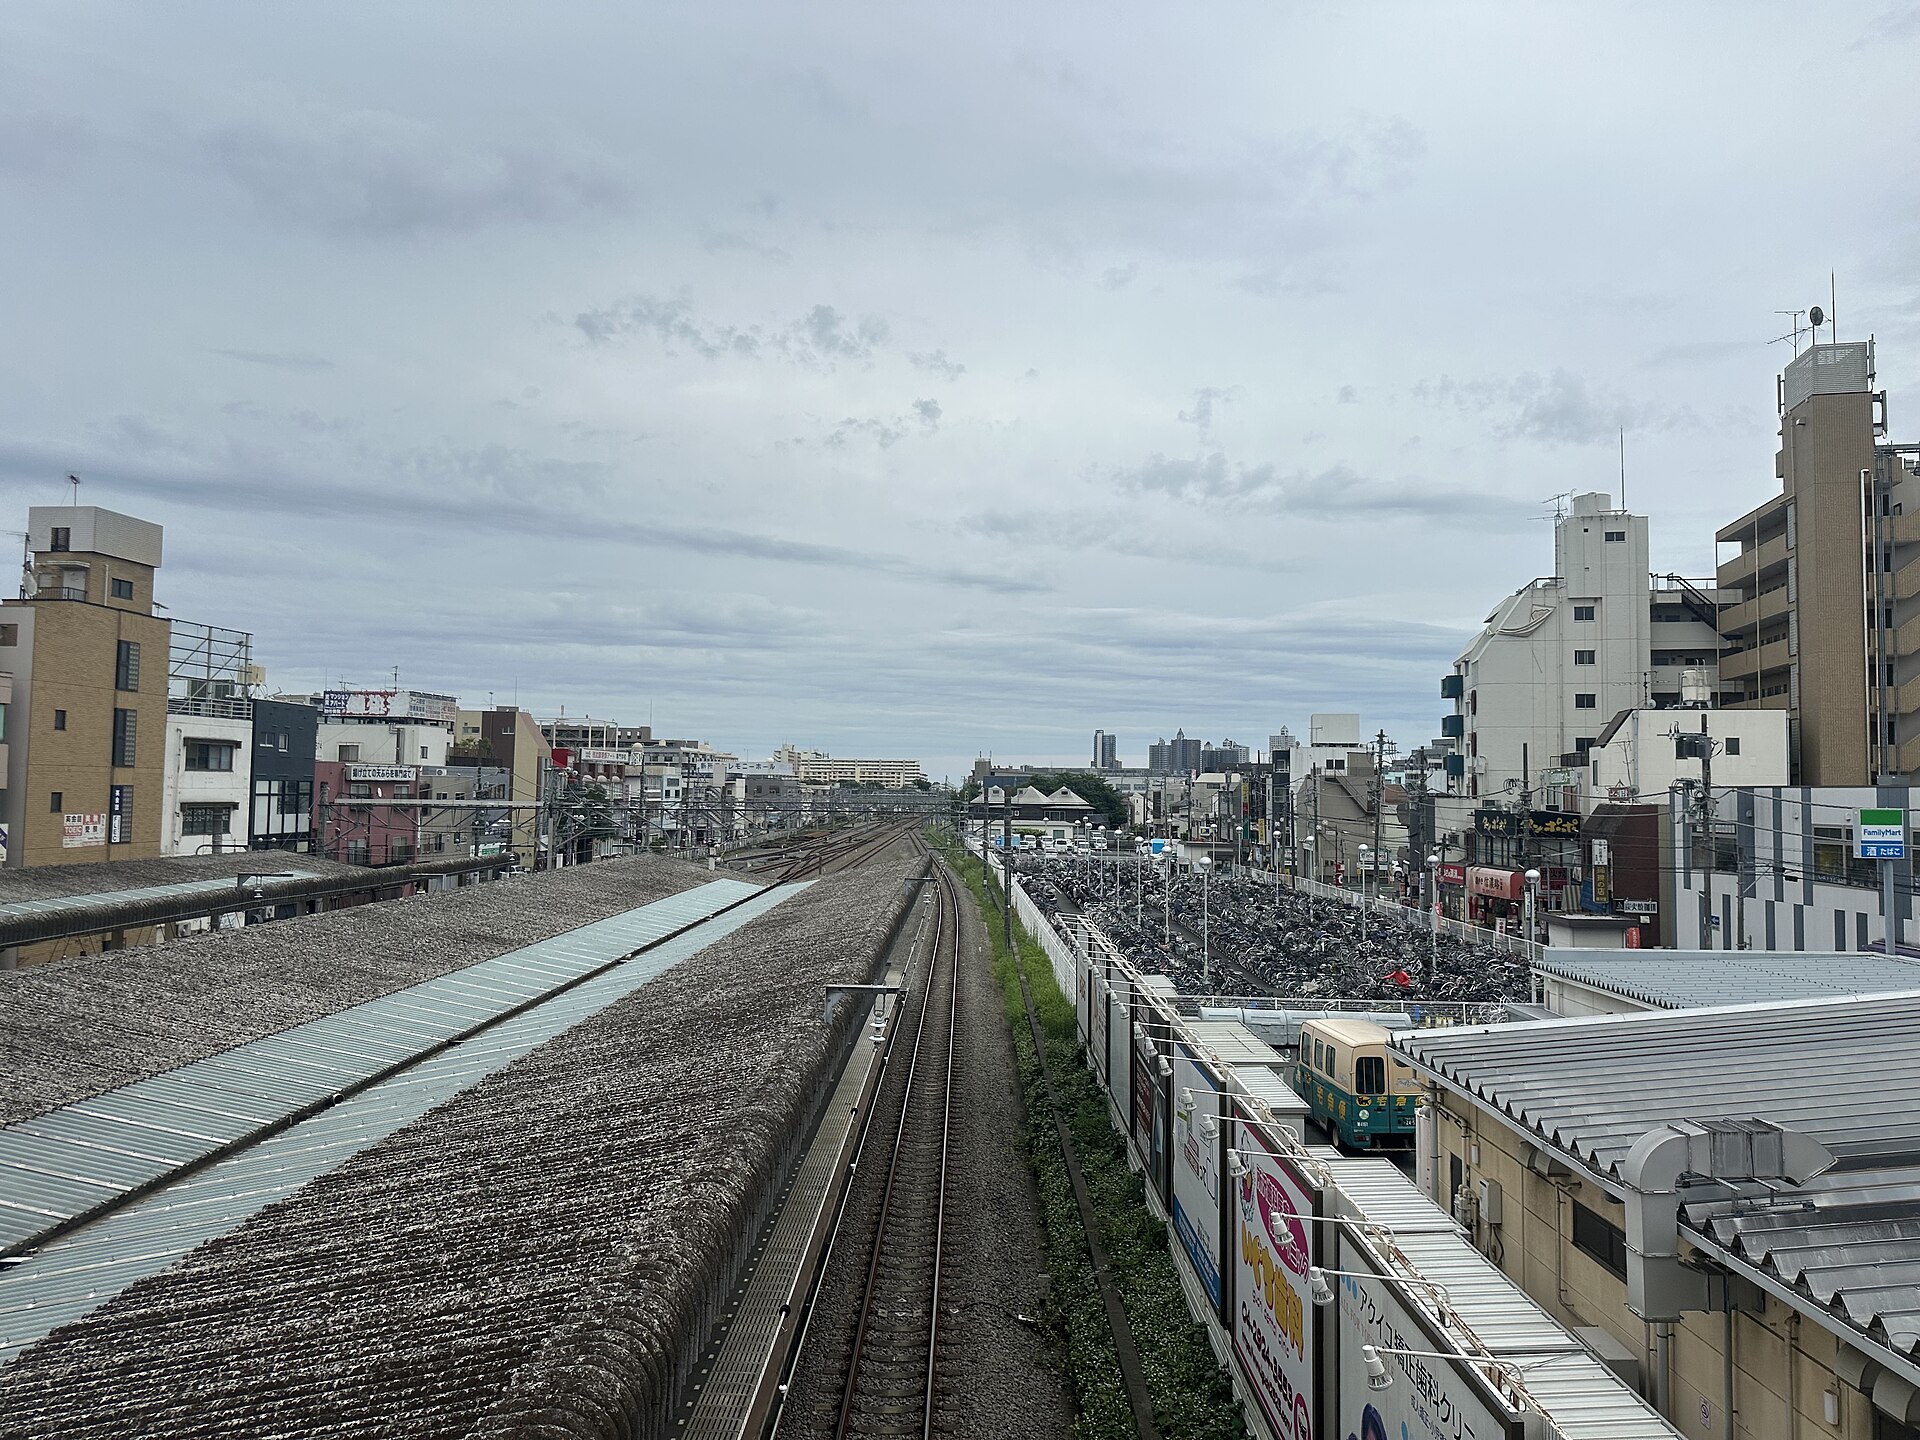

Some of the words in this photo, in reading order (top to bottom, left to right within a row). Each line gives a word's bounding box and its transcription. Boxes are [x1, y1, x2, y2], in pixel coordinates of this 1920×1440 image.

[700, 762, 776, 770] 新所レモニーホール
[1863, 828, 1902, 837] FamilyMart
[1866, 846, 1877, 857] 酒
[1880, 848, 1901, 856] たばこ
[1316, 1086, 1347, 1121] 宅急便
